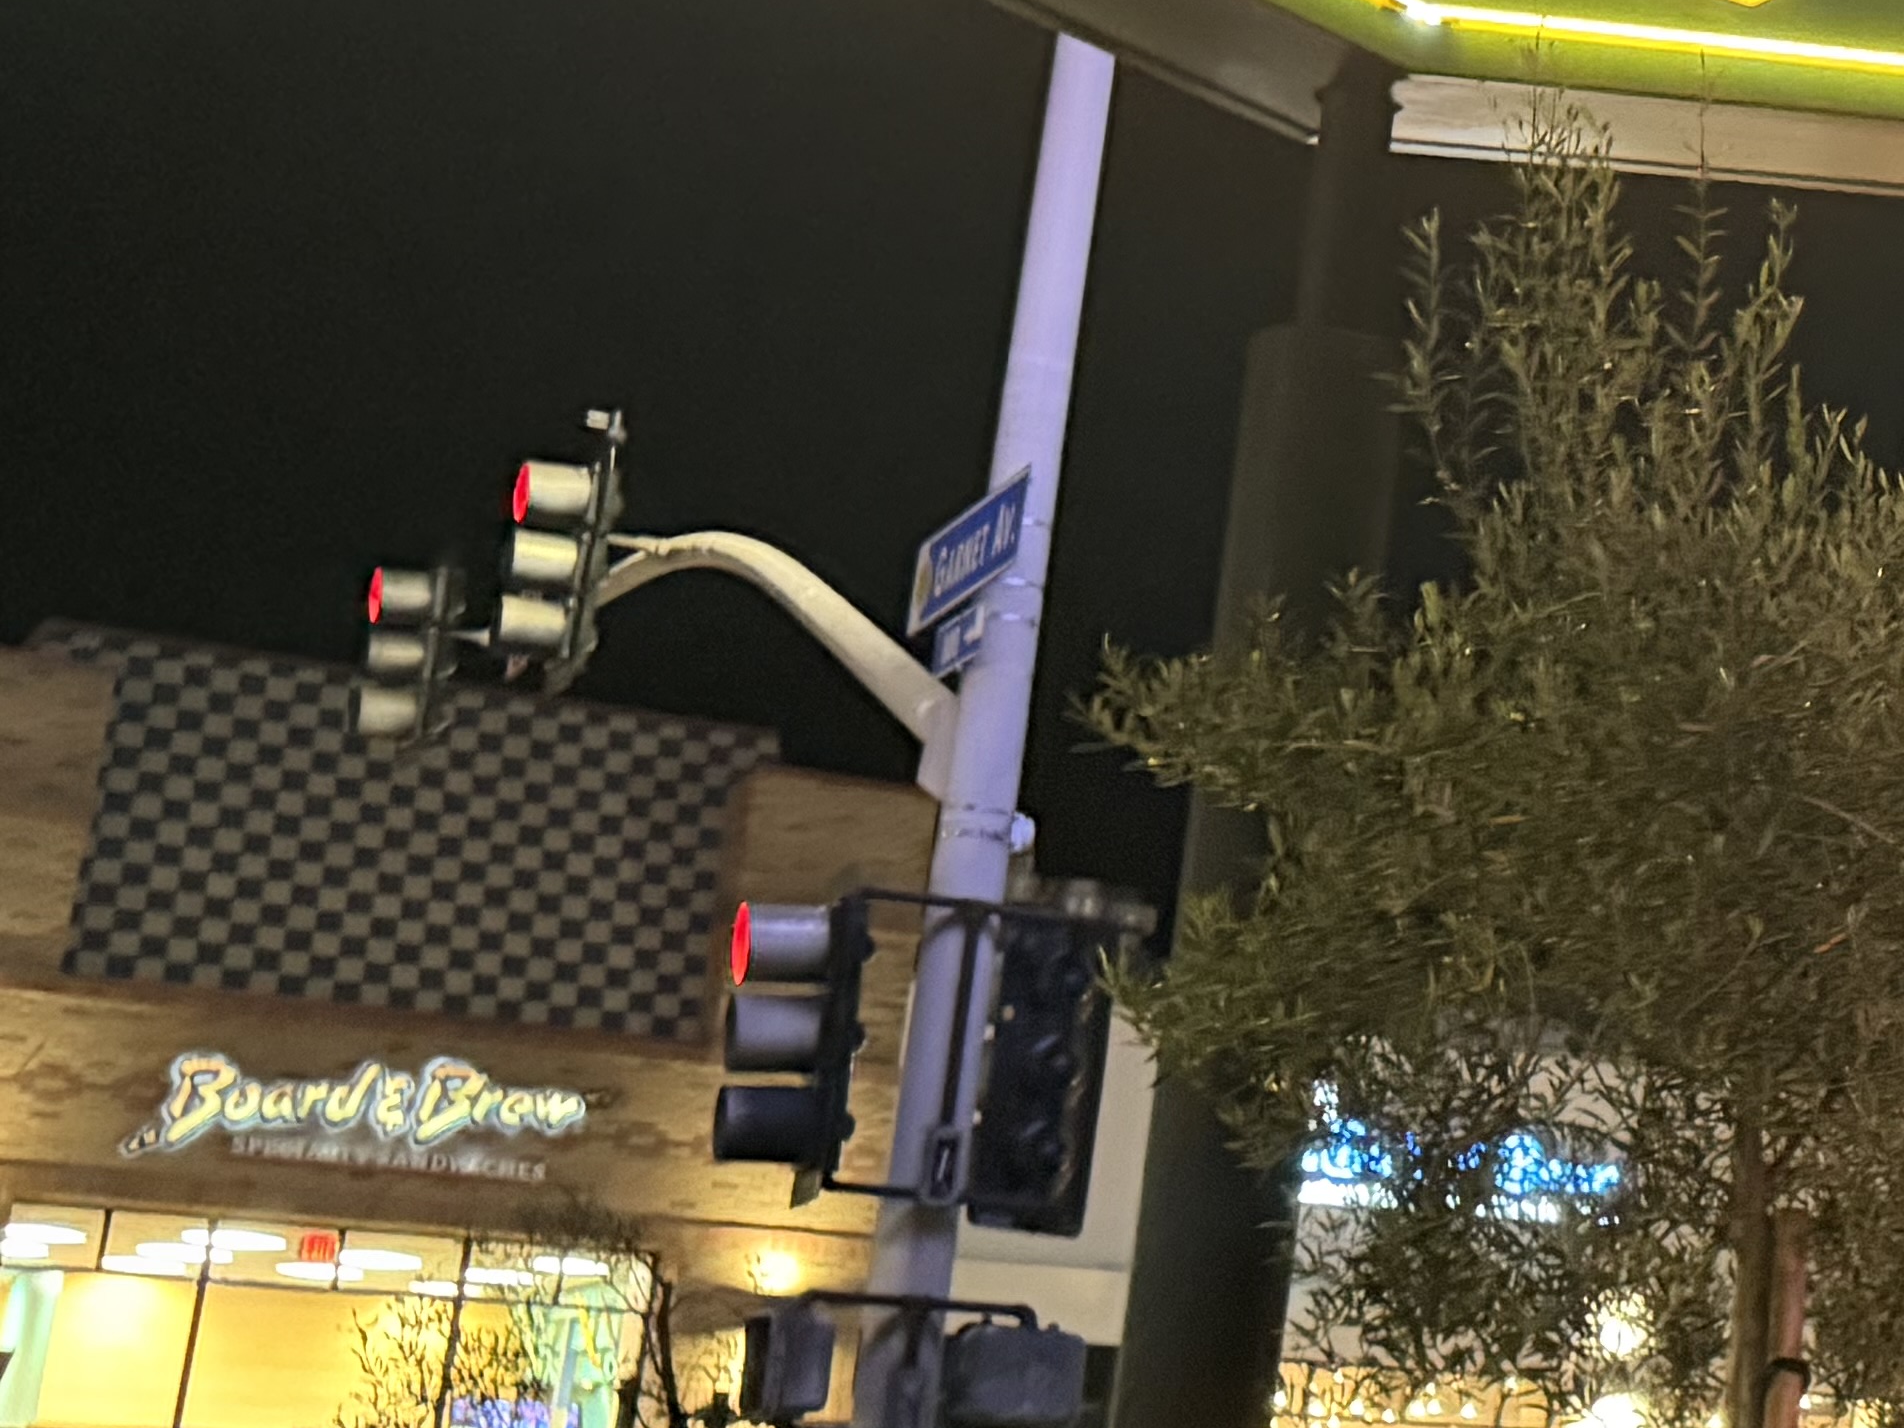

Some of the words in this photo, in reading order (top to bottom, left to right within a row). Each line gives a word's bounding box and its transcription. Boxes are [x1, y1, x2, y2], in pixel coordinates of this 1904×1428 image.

[160, 1052, 386, 1152] Board
[376, 1072, 416, 1142] &
[408, 1054, 588, 1150] Brew
